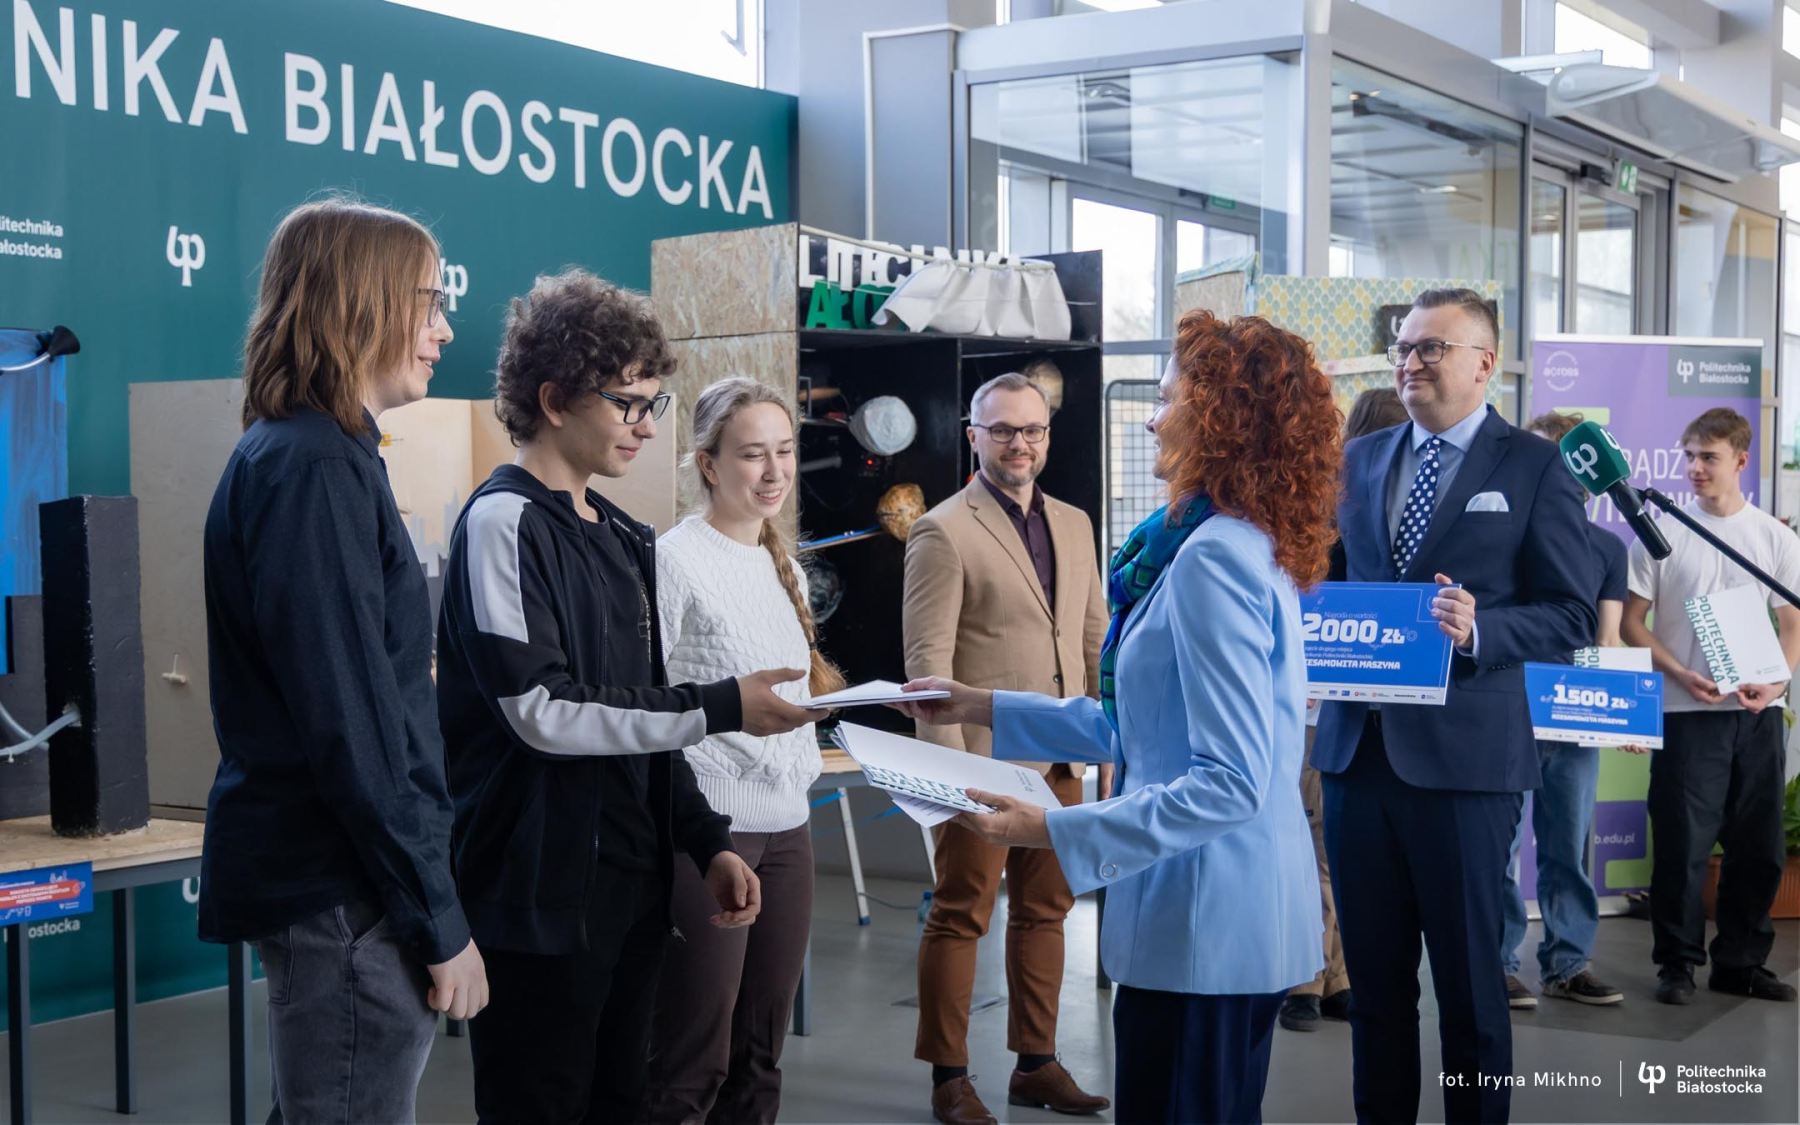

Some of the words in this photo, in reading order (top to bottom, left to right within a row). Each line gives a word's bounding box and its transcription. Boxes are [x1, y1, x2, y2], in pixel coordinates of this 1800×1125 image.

[285, 52, 774, 219] BIAŁOSTOCKA
[1699, 361, 1751, 374] Politechnika
[1699, 373, 1750, 385] Białostocka
[1303, 612, 1378, 643] 2000
[1683, 598, 1726, 683] BIAŁOSTOCKA
[1697, 595, 1740, 684] POLITECHNIKA
[1359, 660, 1401, 670] MASZYNA
[1553, 684, 1609, 707] 1500
